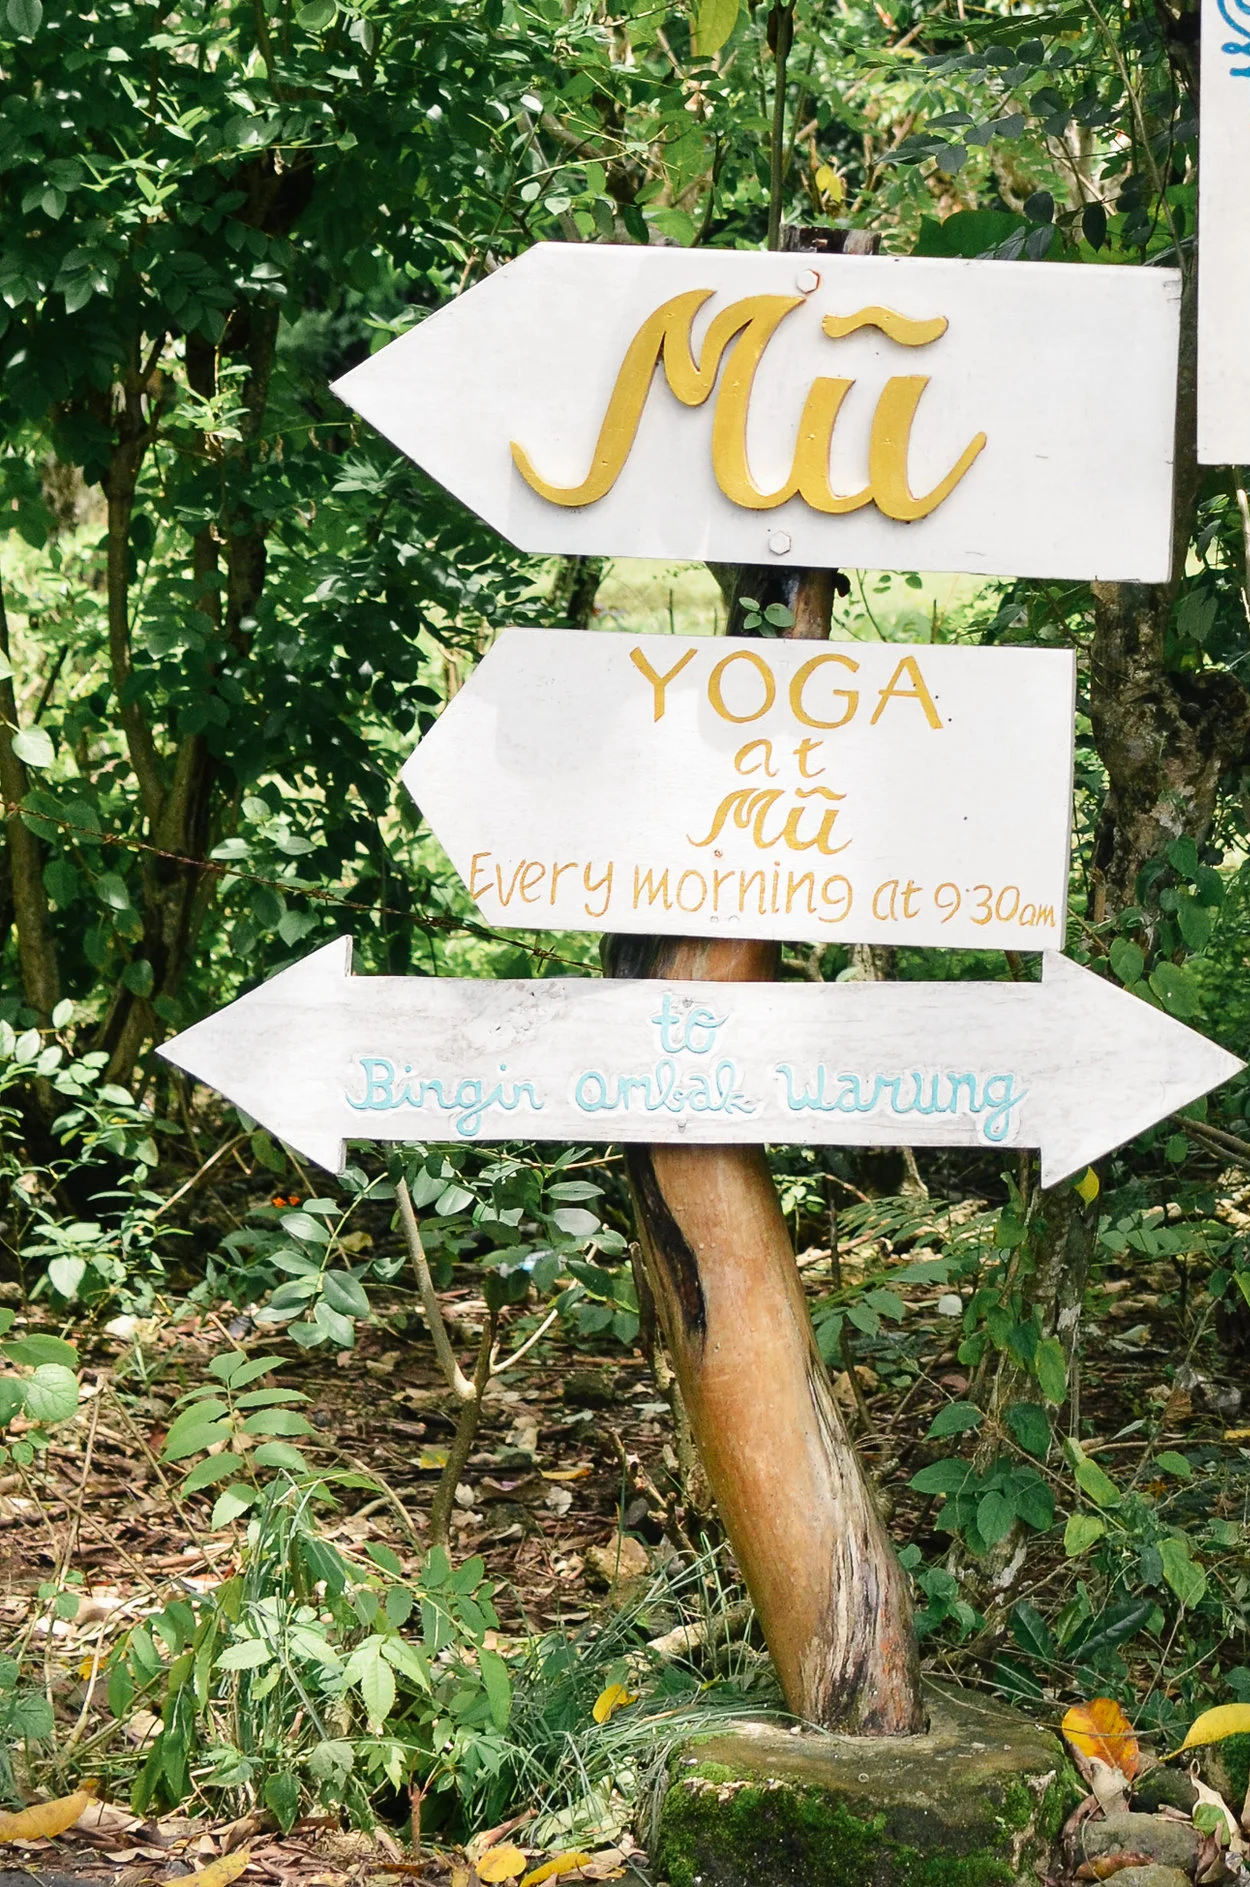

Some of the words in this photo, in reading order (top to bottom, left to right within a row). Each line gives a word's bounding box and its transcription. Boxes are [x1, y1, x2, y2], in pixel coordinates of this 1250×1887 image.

[629, 646, 944, 729] YOGA
[733, 737, 827, 779] at
[470, 852, 613, 918] Every
[633, 862, 853, 923] morning
[872, 879, 922, 922] at
[651, 994, 729, 1054] to
[345, 1057, 545, 1136] Bingin
